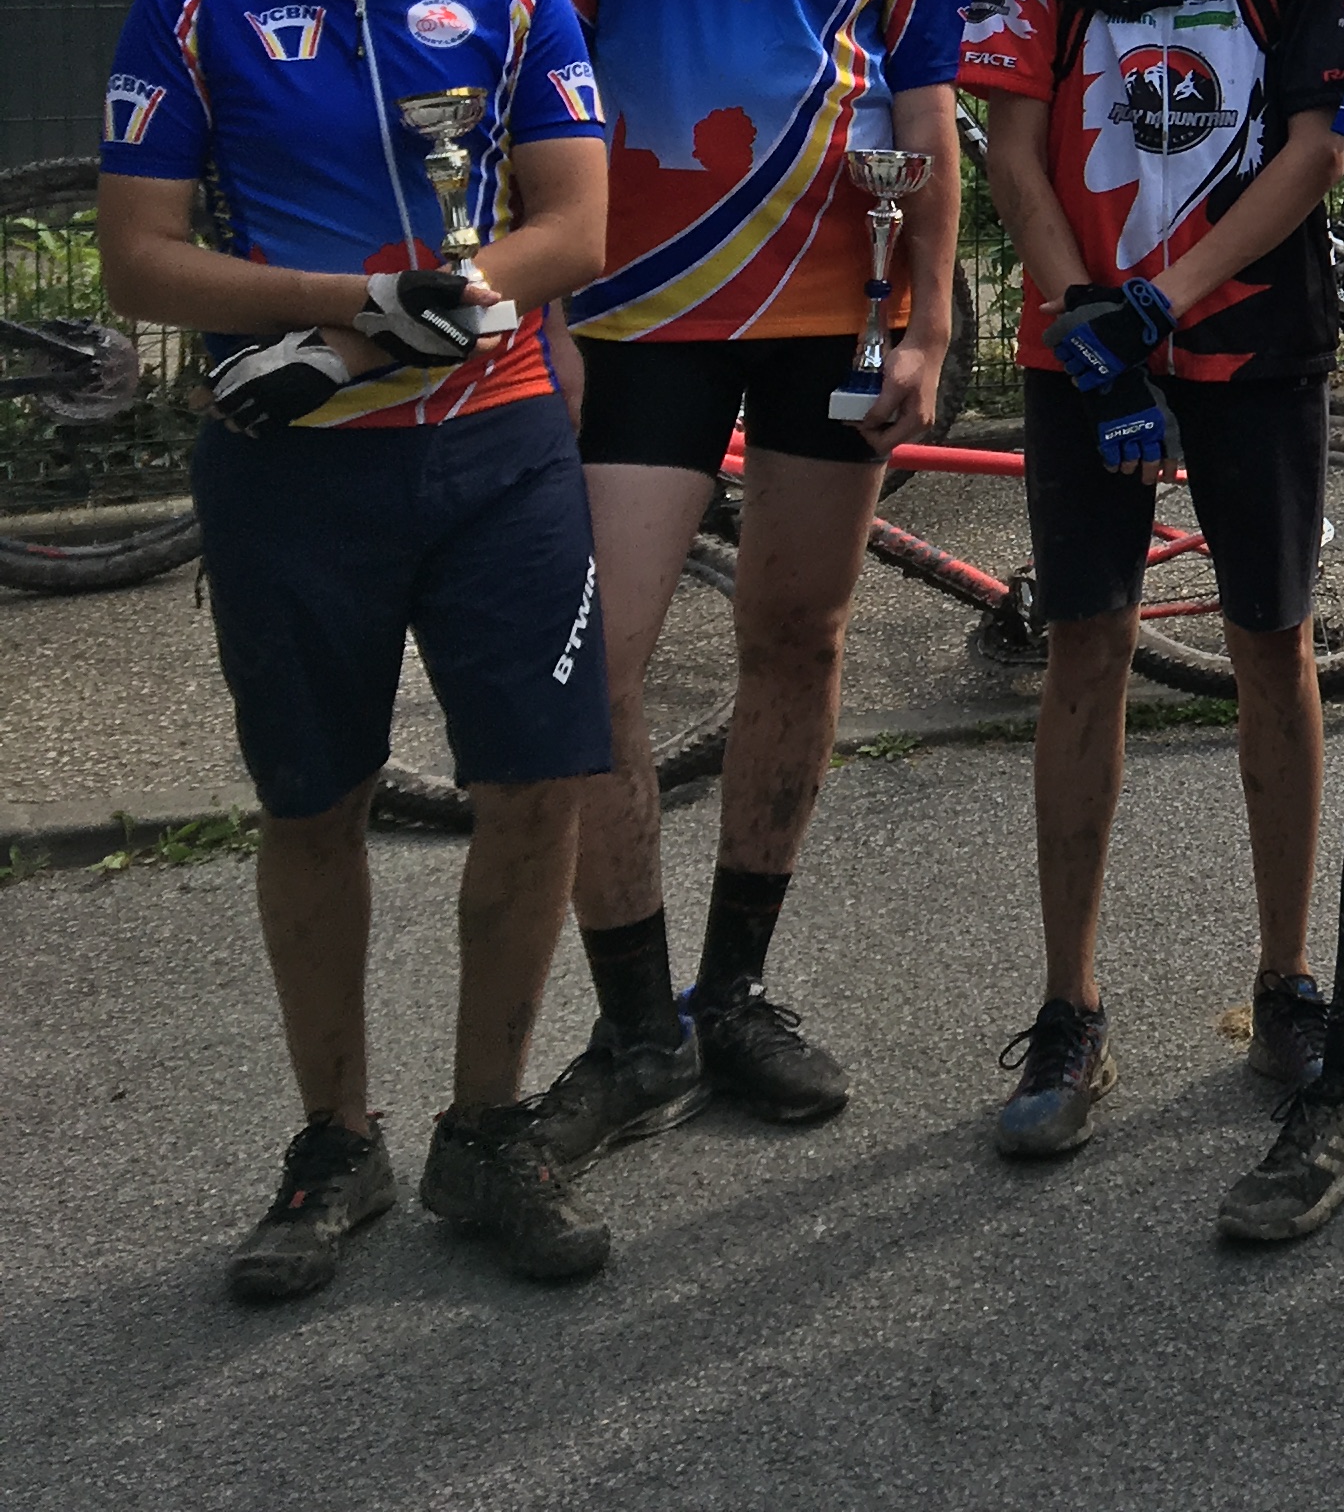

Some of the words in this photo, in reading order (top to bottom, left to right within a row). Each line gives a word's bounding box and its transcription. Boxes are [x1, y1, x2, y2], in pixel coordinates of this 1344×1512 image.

[255, 6, 318, 26] VCBN
[964, 50, 1018, 69] FACE
[420, 309, 470, 347] SHIMANO
